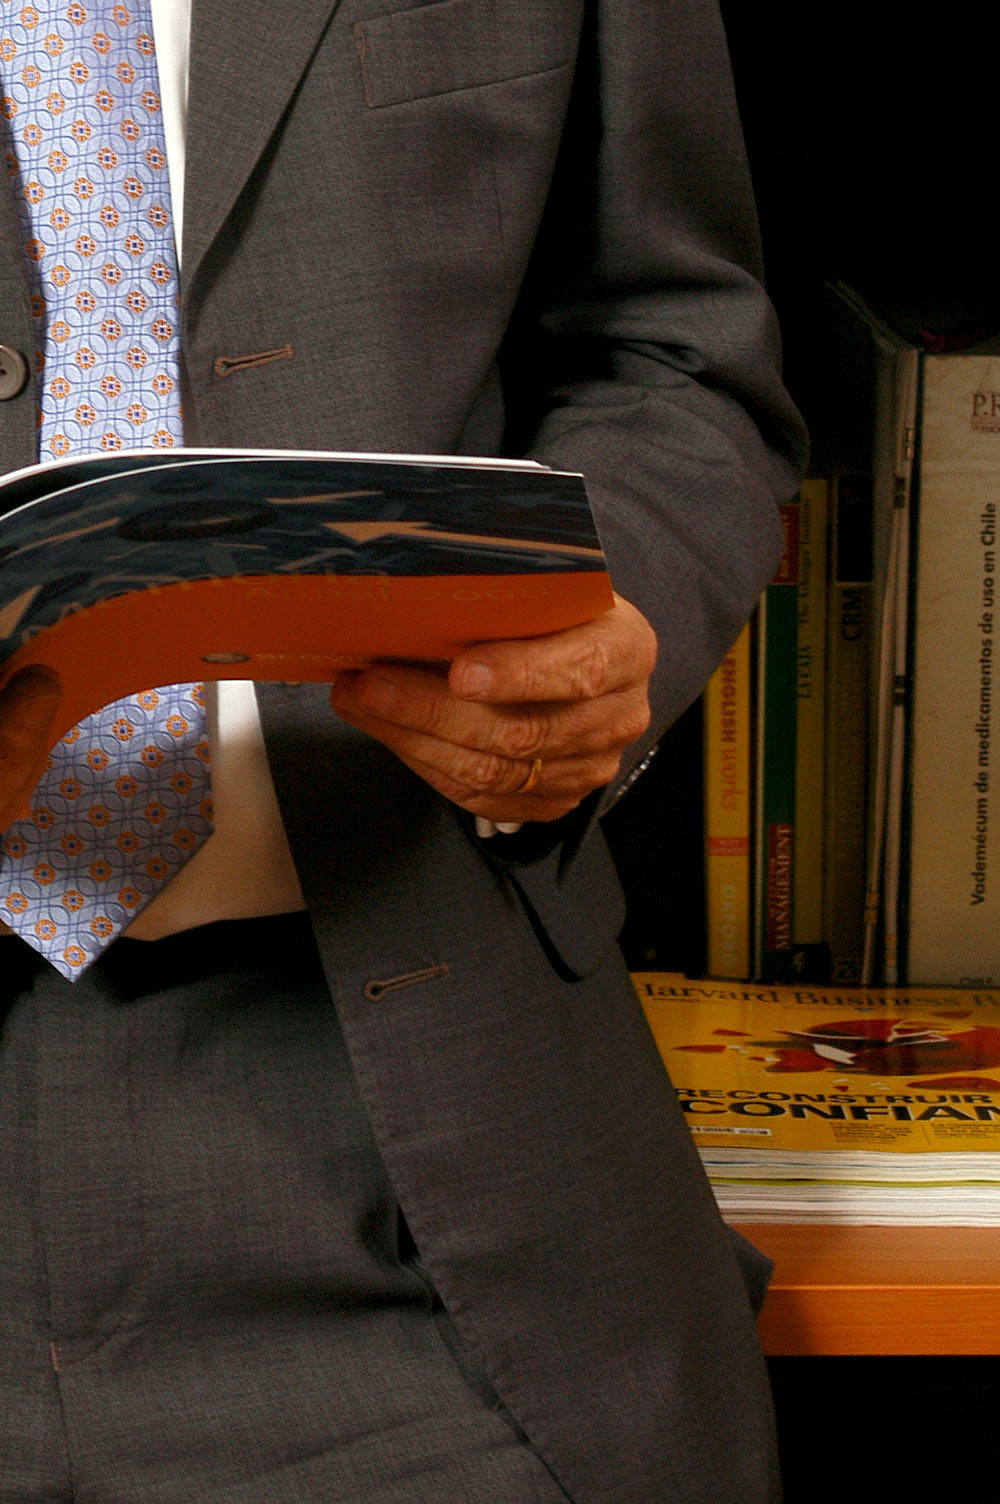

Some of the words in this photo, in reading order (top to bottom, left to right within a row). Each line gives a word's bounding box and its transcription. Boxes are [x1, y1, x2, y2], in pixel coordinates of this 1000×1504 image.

[980, 502, 996, 547] Chile
[984, 553, 995, 573] en
[840, 589, 863, 641] CRM
[981, 578, 995, 609] uso
[977, 612, 993, 634] de
[720, 658, 736, 743] ENGLISH
[975, 638, 993, 768] medicamentos
[974, 772, 988, 794] de
[971, 799, 988, 907] Vademécum
[775, 827, 791, 951] MANAGEMENT
[720, 883, 735, 967] OXFORD
[793, 991, 961, 1010] Business
